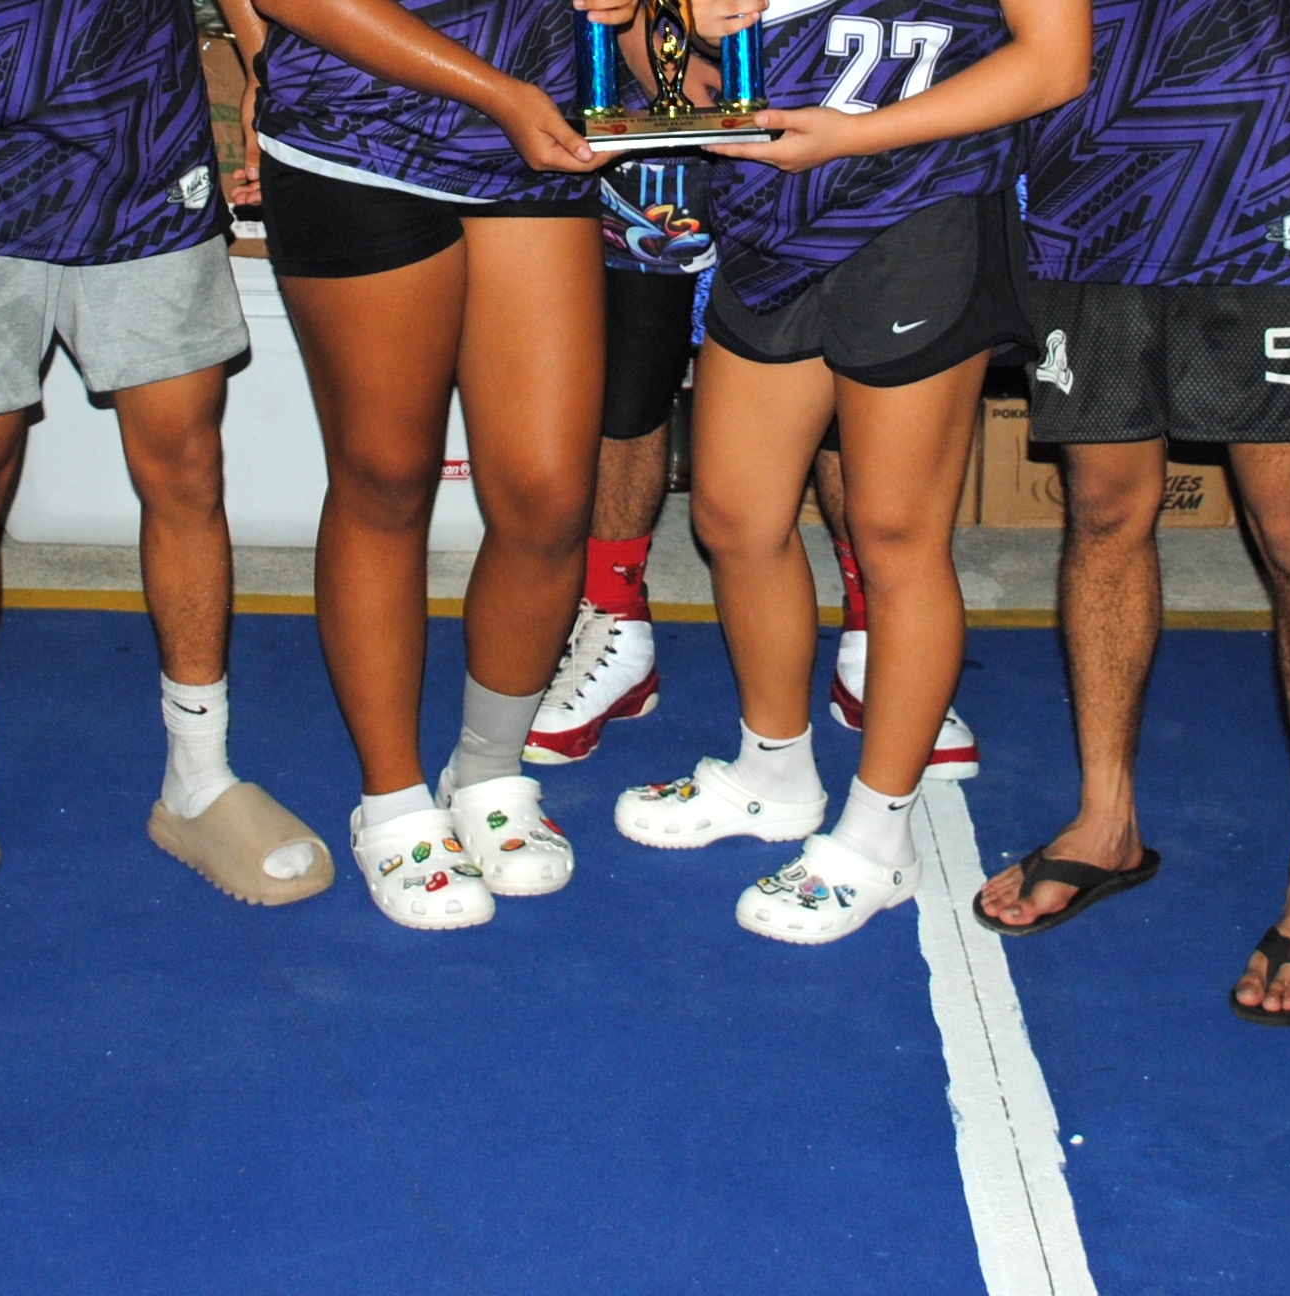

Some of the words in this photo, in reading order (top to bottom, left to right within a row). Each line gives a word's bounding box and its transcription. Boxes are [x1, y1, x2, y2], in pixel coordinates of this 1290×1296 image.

[825, 15, 954, 114] 27
[1164, 475, 1204, 491] KIES
[1161, 494, 1204, 511] EAM
